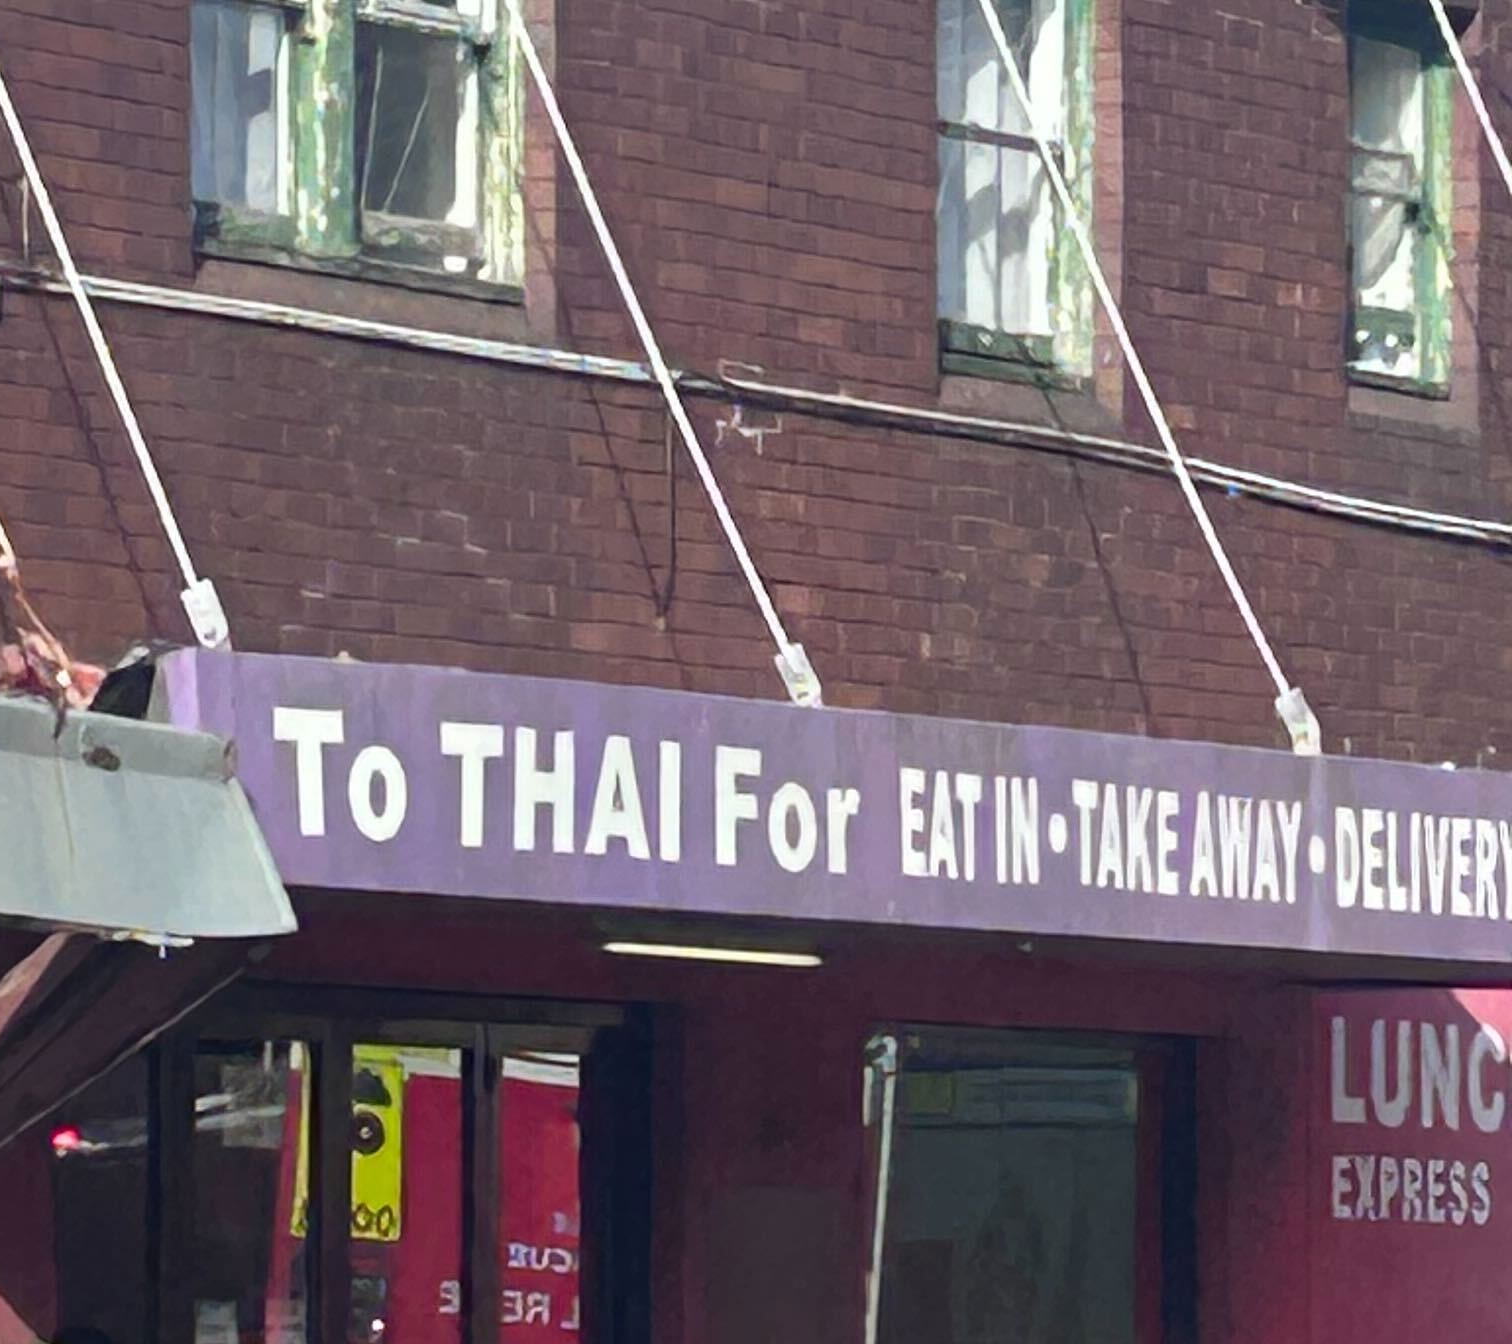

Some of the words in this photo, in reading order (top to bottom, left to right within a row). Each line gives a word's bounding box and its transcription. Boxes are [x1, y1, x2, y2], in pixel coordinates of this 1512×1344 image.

[273, 706, 407, 843] To
[440, 722, 681, 863] THAI
[715, 744, 860, 875] For
[899, 766, 982, 882] EAT
[1072, 778, 1179, 896] TAKE
[1190, 790, 1302, 903] AWAY
[1332, 1015, 1512, 1133] LUNC
[1331, 1154, 1490, 1226] EXPRESS
